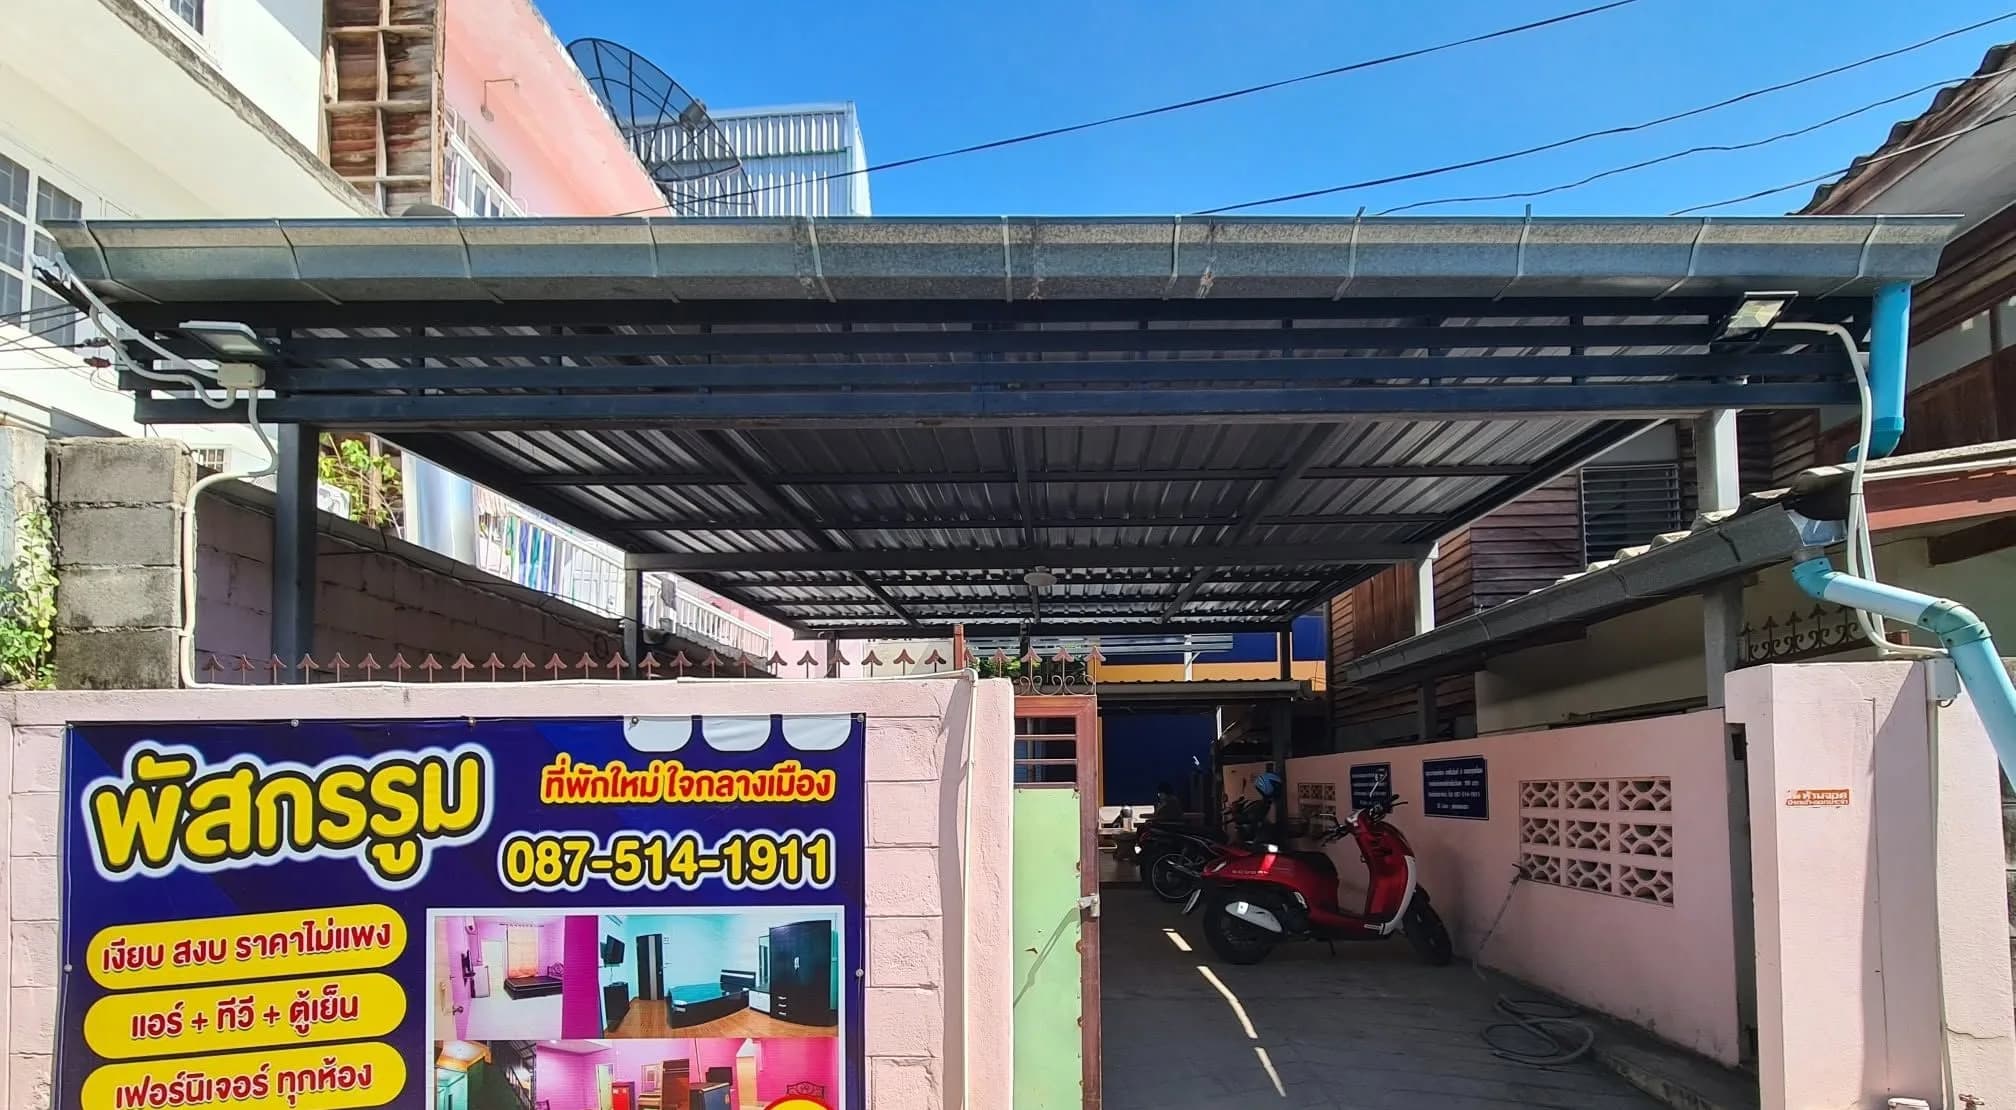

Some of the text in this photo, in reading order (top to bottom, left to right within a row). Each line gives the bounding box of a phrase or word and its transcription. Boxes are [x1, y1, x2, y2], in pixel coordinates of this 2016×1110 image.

[544, 756, 832, 799] ที่พักใหม่ ใจกลางเมือง
[94, 749, 485, 880] พัสกรรูม
[504, 836, 830, 885] 087-514-1911
[103, 917, 391, 971] เงียบ สงบ ราคาไม่แพง
[131, 1001, 184, 1038] แอร์
[217, 995, 256, 1030] ทีวี
[290, 984, 358, 1035] ตู้เย็น
[115, 1057, 372, 1109] เฟอร์นิเจอร์ ทุกห้อง
